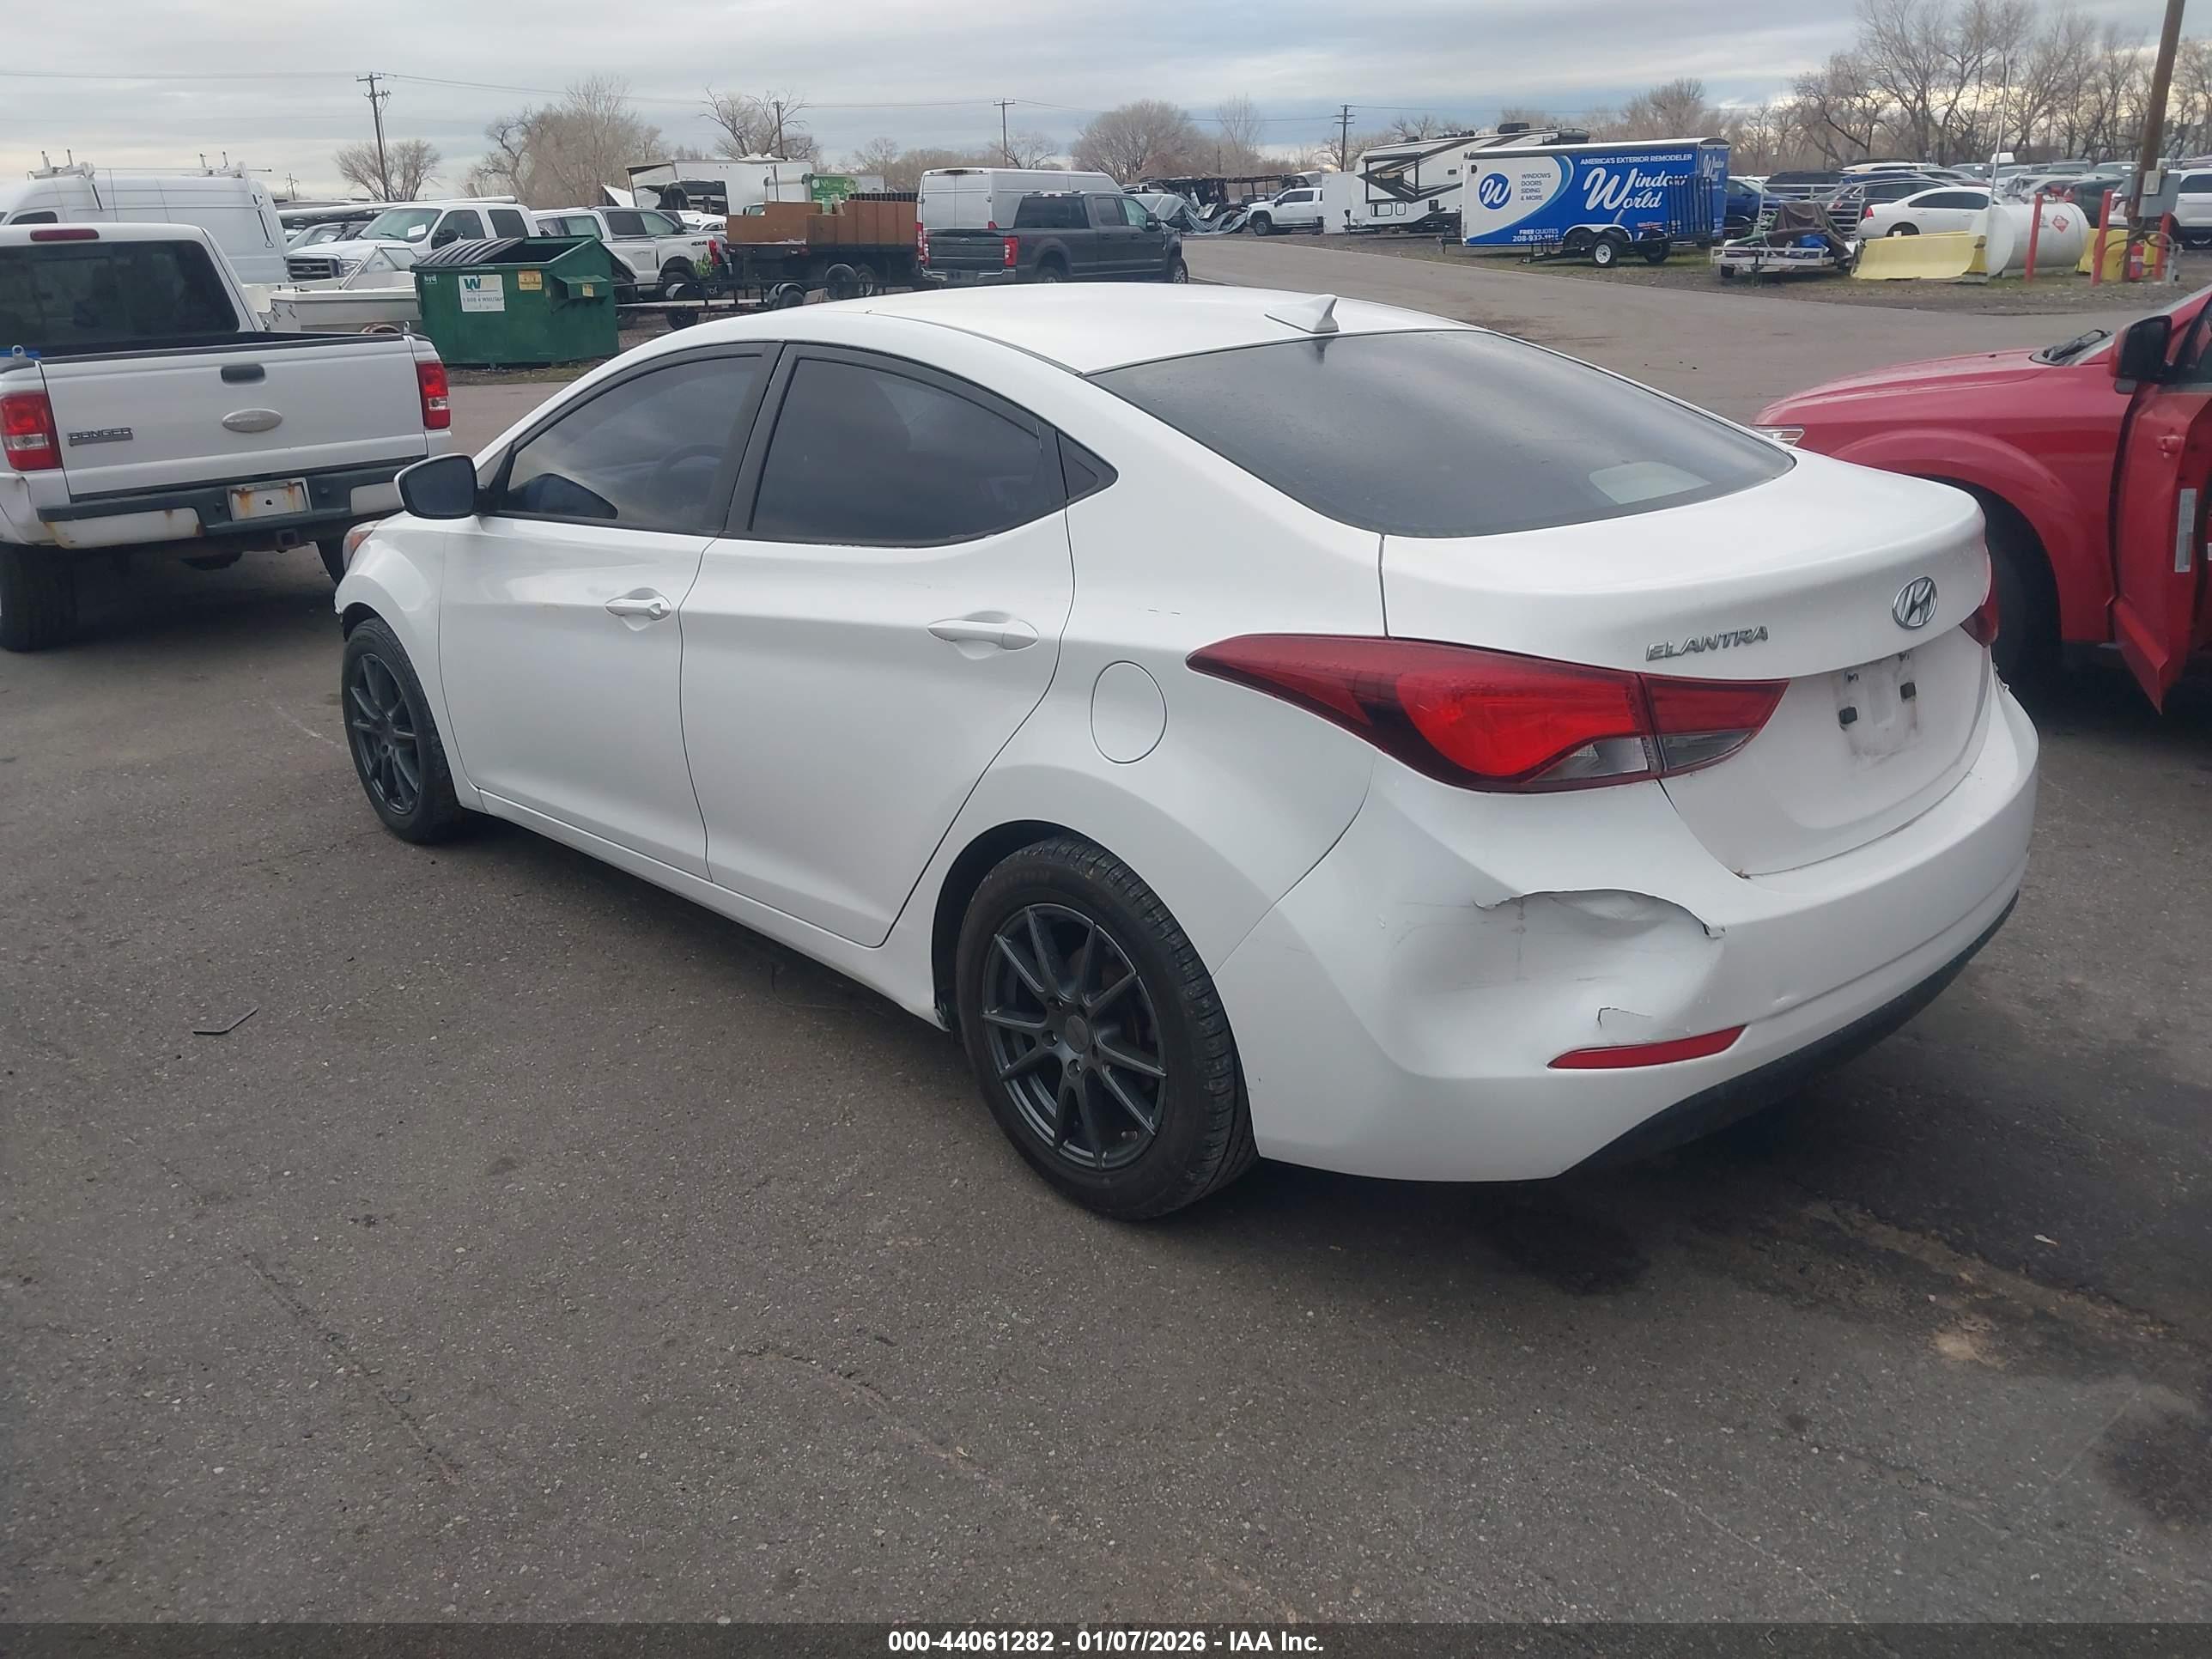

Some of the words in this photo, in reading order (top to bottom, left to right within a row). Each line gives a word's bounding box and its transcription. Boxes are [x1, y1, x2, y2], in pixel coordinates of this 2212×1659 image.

[1580, 157, 1615, 166] AMERICA'S
[1616, 155, 1649, 164] EXTERIOR
[1650, 154, 1692, 162] REMODELER
[68, 427, 132, 441] RANGER
[1646, 625, 1769, 661] ELANTRA
